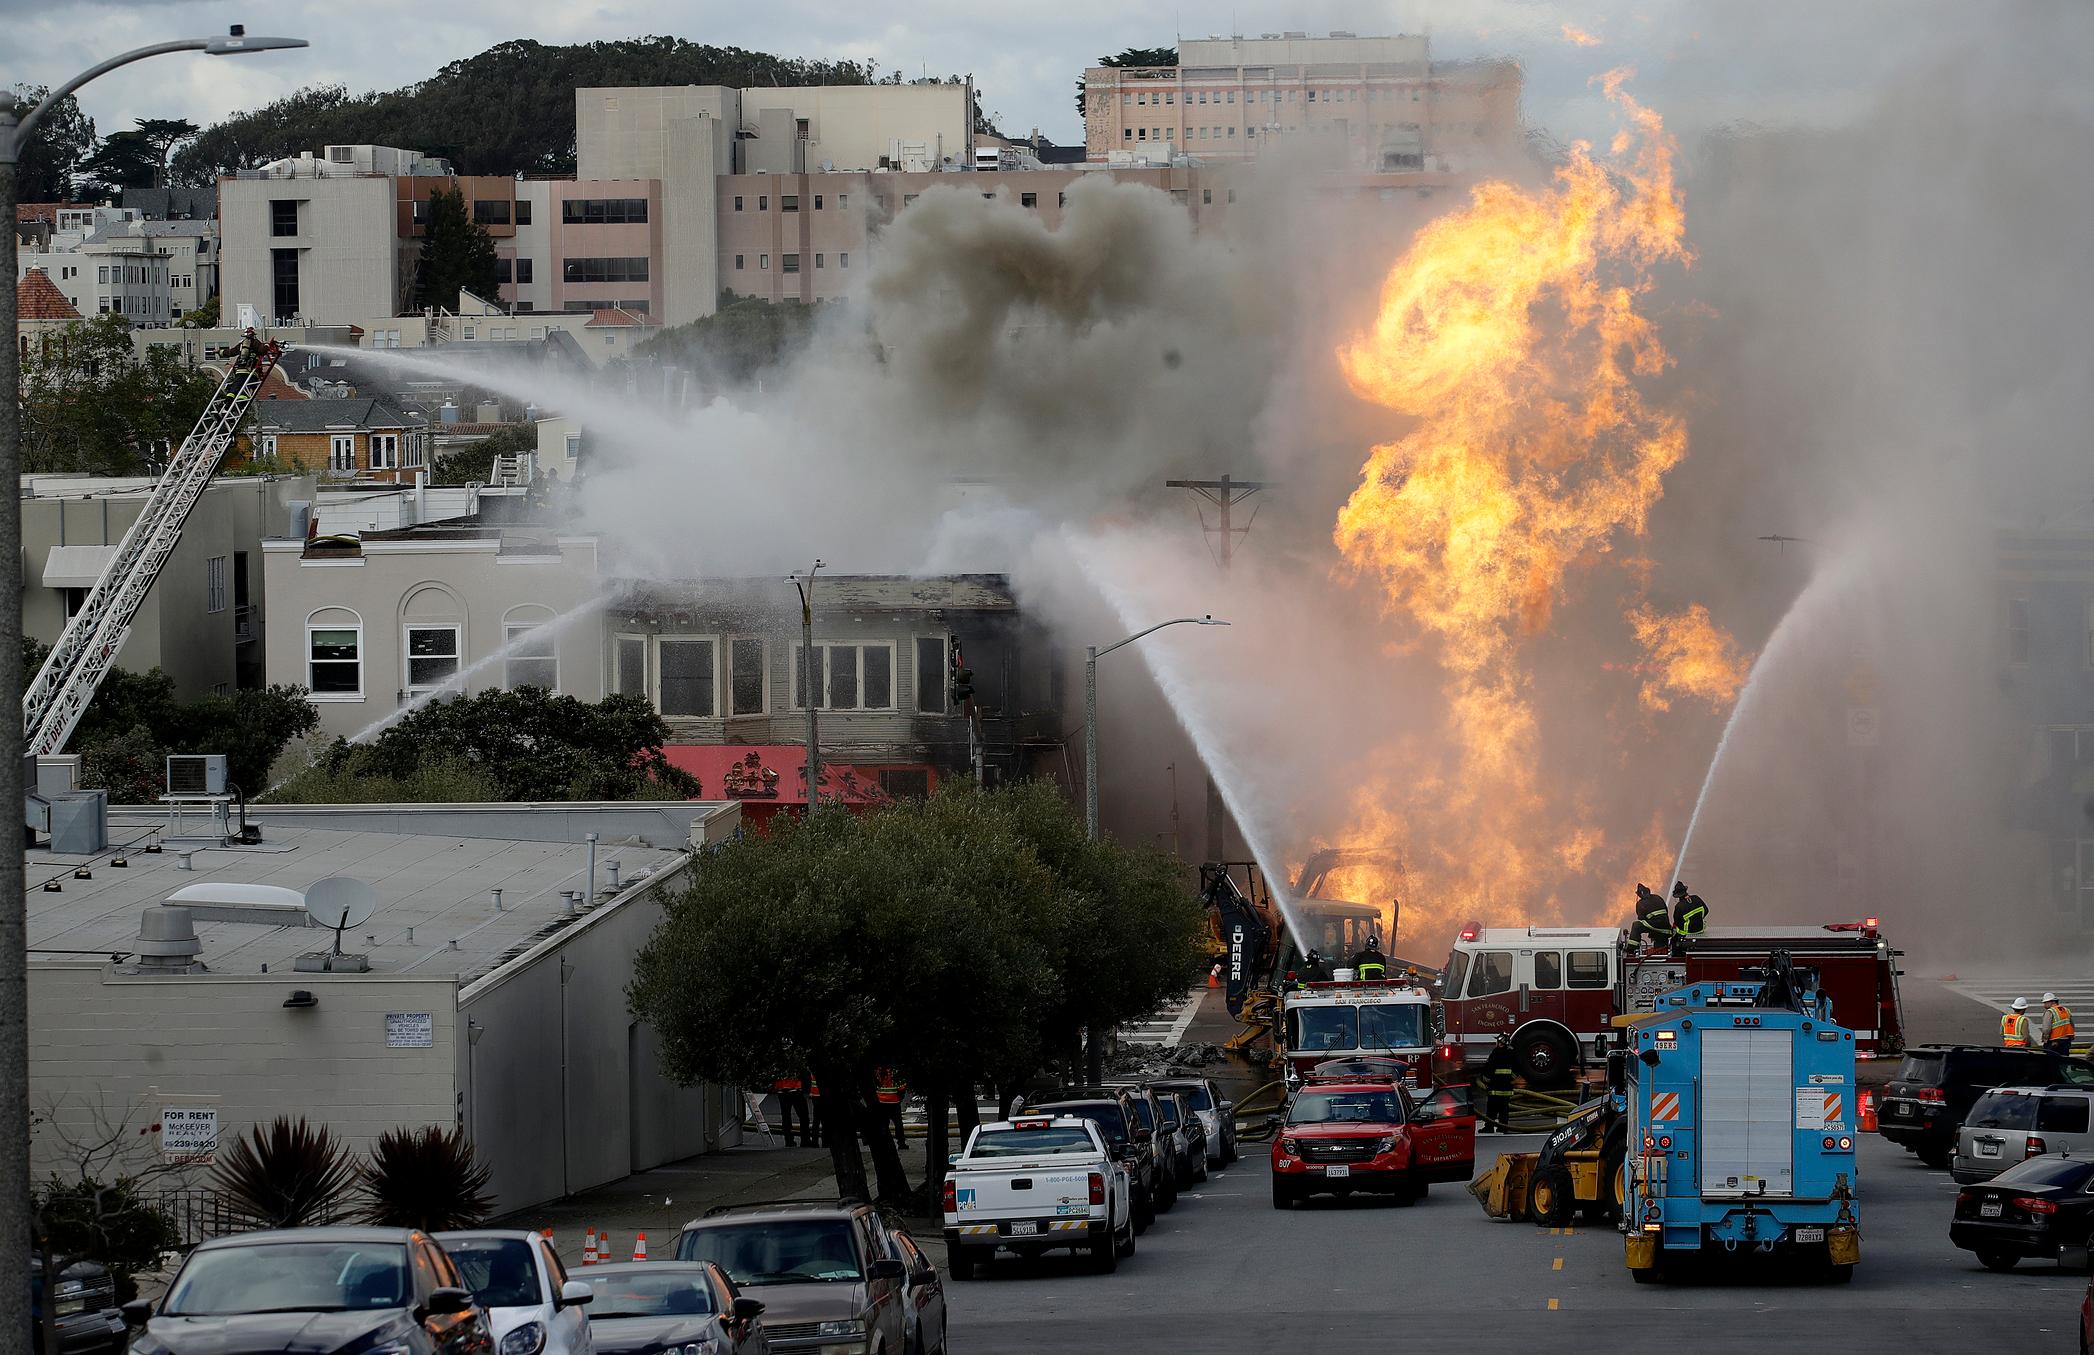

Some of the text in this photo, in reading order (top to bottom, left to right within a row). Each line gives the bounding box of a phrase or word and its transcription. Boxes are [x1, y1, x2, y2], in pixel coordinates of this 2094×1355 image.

[50, 713, 69, 743] DEPT.
[1231, 932, 1244, 981] DEERE
[1407, 1054, 1420, 1063] RP
[164, 1111, 215, 1120] FOR RENT
[168, 1123, 211, 1131] McKEEVER
